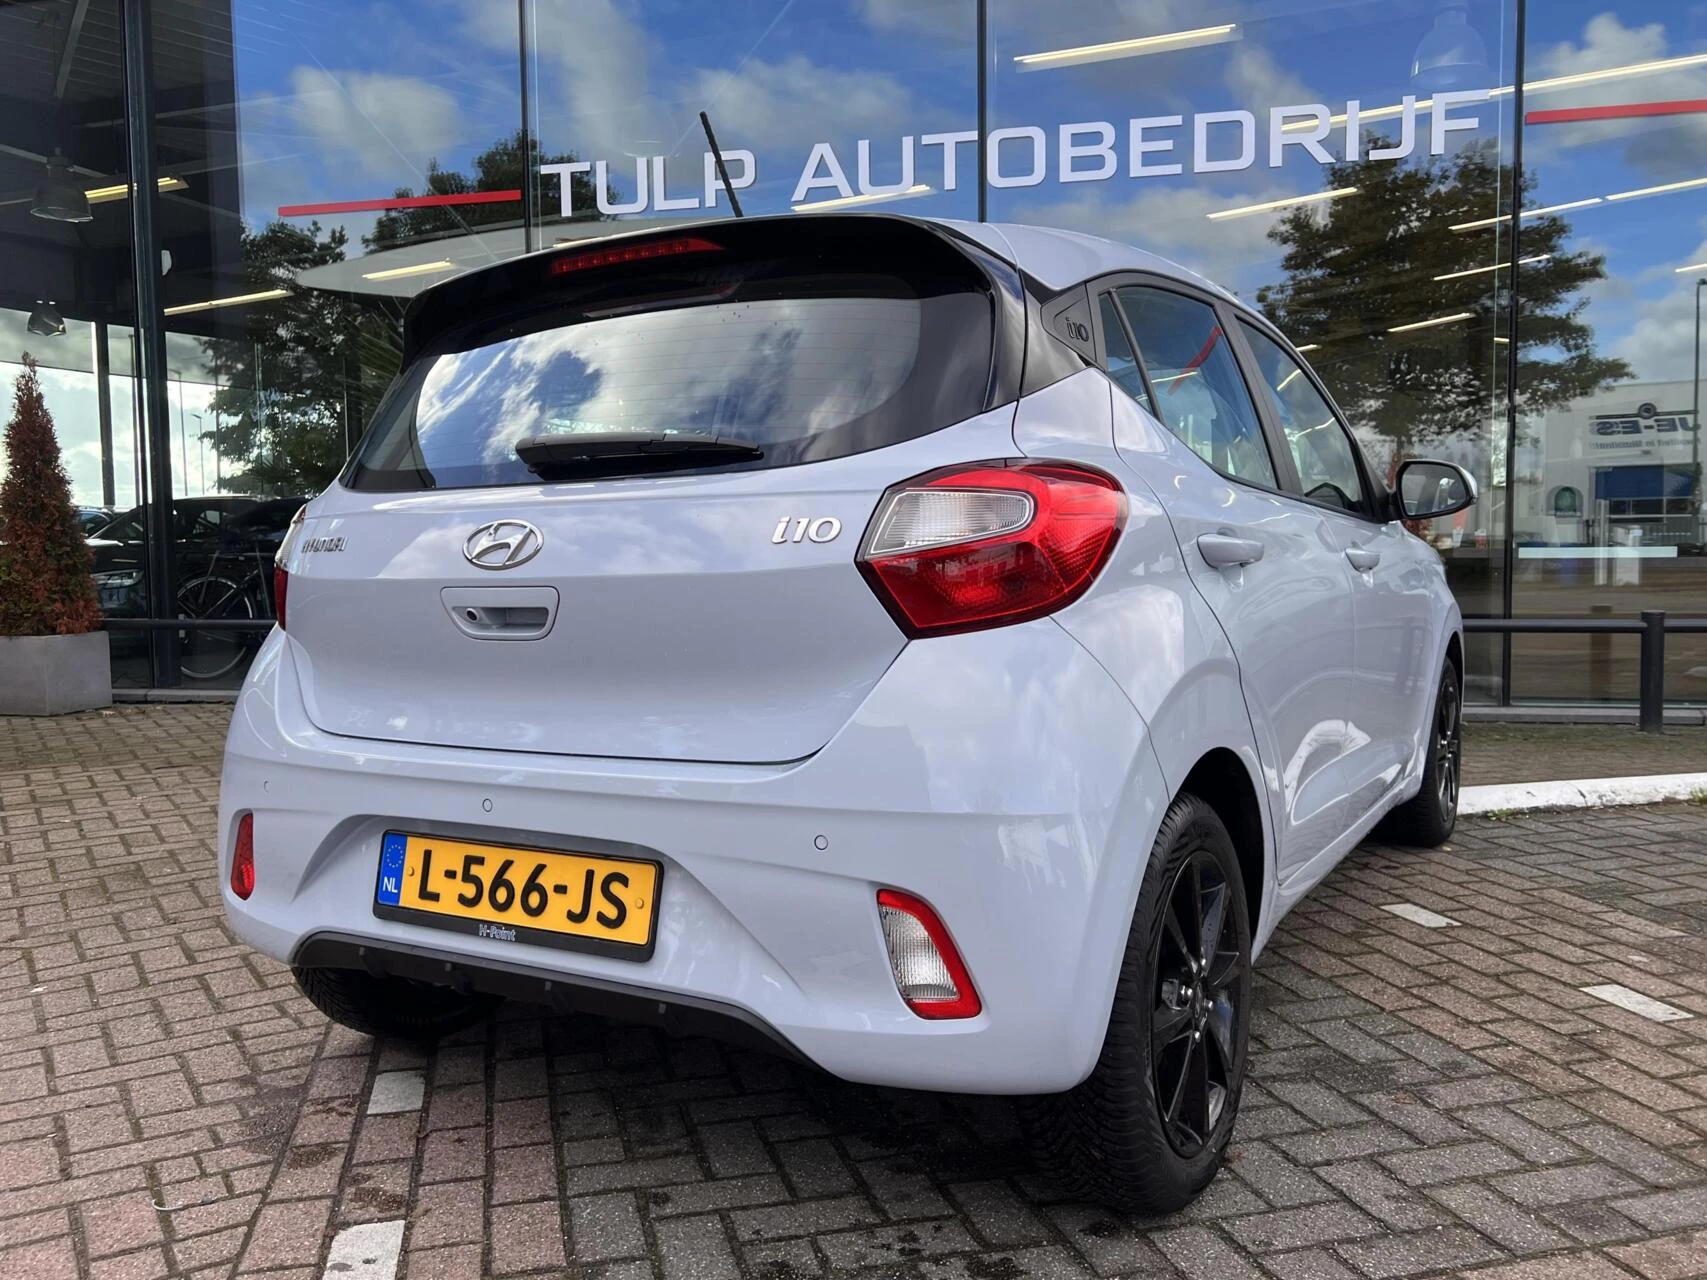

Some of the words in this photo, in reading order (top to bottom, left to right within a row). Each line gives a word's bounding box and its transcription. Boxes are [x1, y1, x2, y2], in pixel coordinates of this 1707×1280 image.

[540, 149, 756, 217] TULP
[791, 89, 1491, 202] AUTOBEDRIJF
[771, 516, 842, 544] i10
[382, 876, 399, 893] NL
[418, 849, 630, 929] L-566-JS
[479, 924, 516, 942] H-Point
